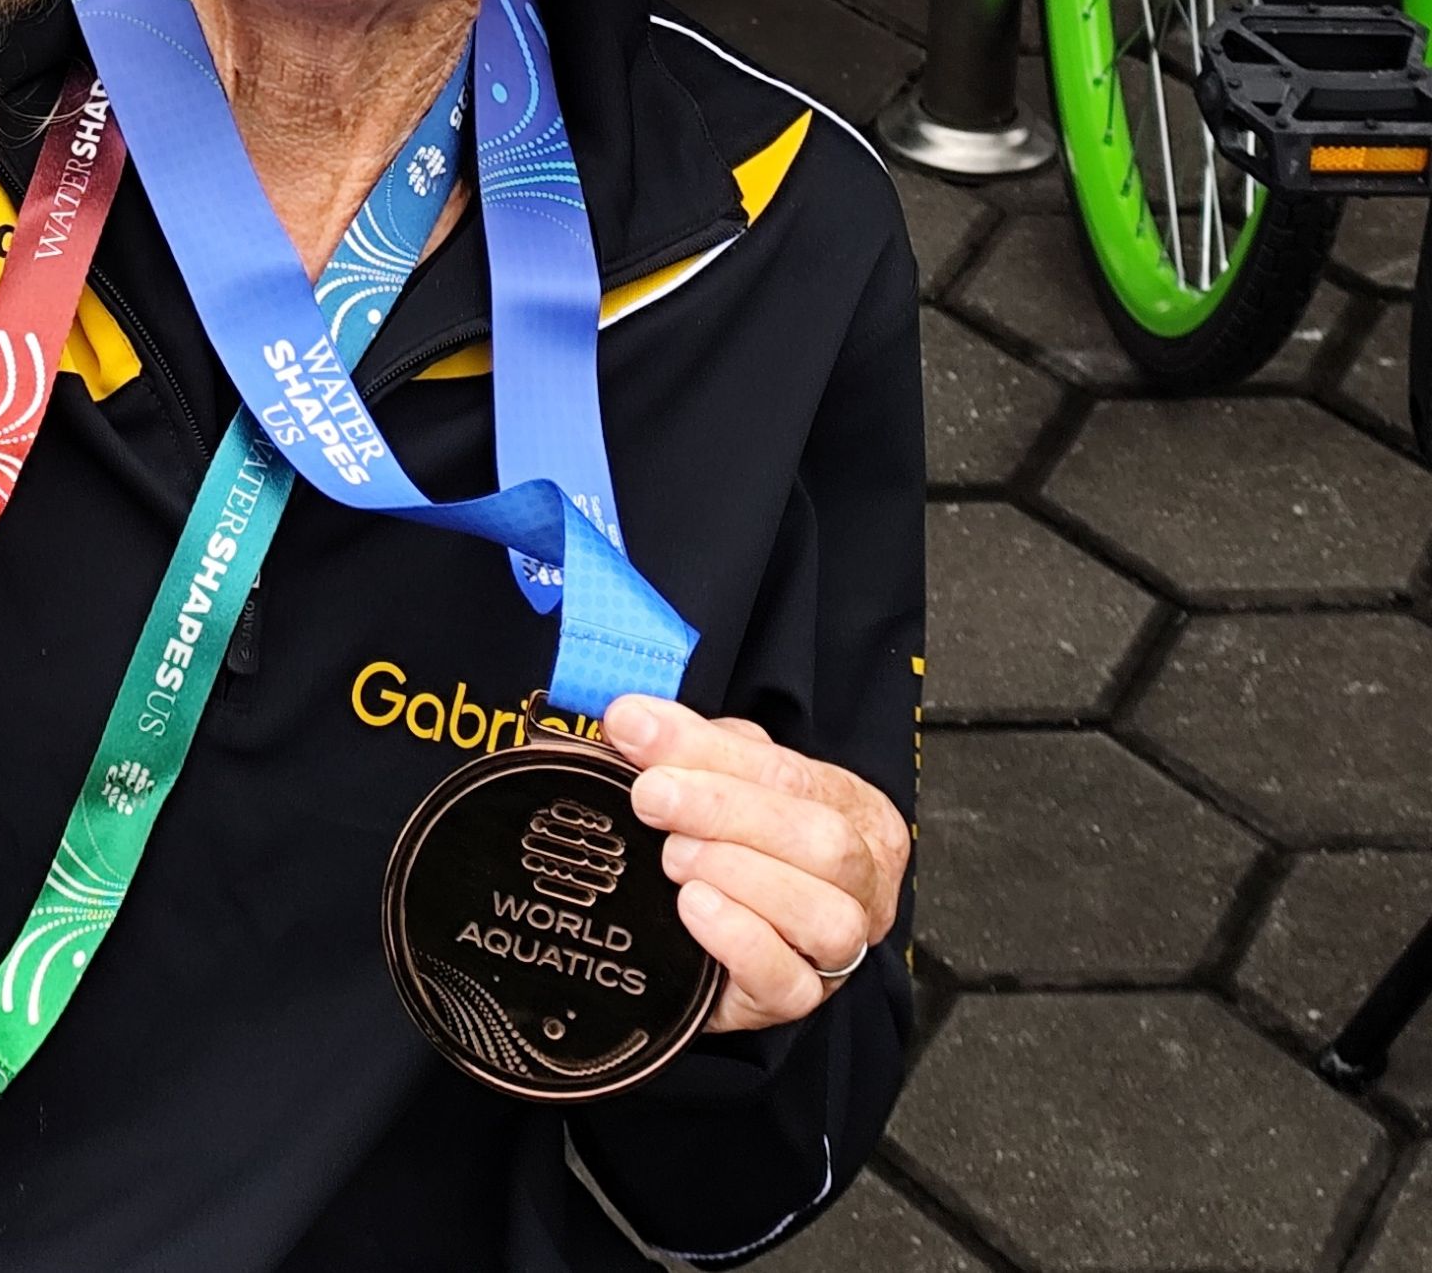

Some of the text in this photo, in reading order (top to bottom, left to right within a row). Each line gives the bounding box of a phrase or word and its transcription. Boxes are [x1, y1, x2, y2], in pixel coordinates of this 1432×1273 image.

[261, 402, 306, 446] US
[263, 339, 371, 485] SHAPES
[302, 334, 385, 466] WATER
[351, 661, 603, 754] Gabri
[456, 920, 647, 997] AQUATICS
[493, 892, 632, 952] WORLD
